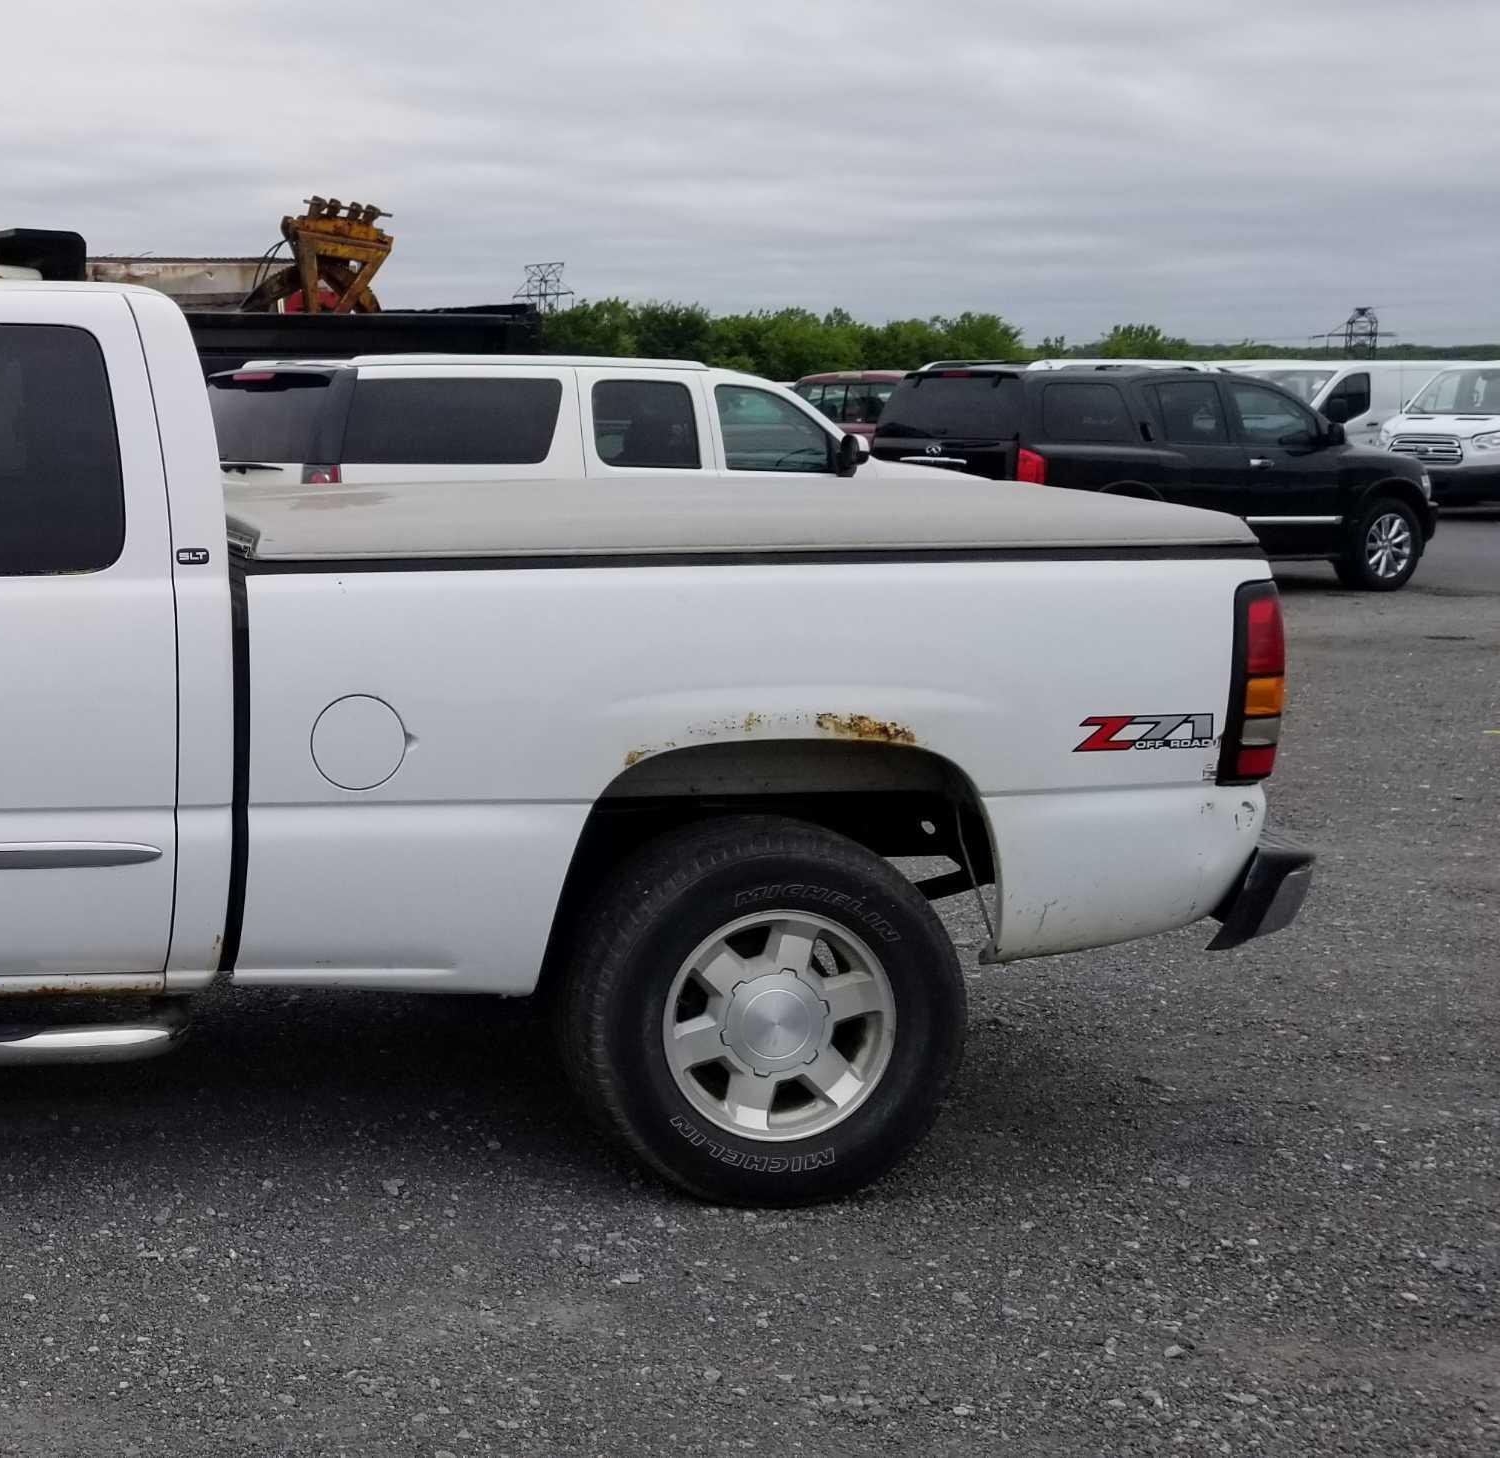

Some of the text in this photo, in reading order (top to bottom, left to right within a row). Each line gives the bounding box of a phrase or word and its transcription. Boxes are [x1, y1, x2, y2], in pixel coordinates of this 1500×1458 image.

[178, 551, 207, 561] SLT
[1072, 713, 1214, 752] Z71
[1135, 738, 1214, 750] OFF ROAD
[735, 883, 902, 944] MICHELIN
[669, 1112, 837, 1173] MICHELIN
